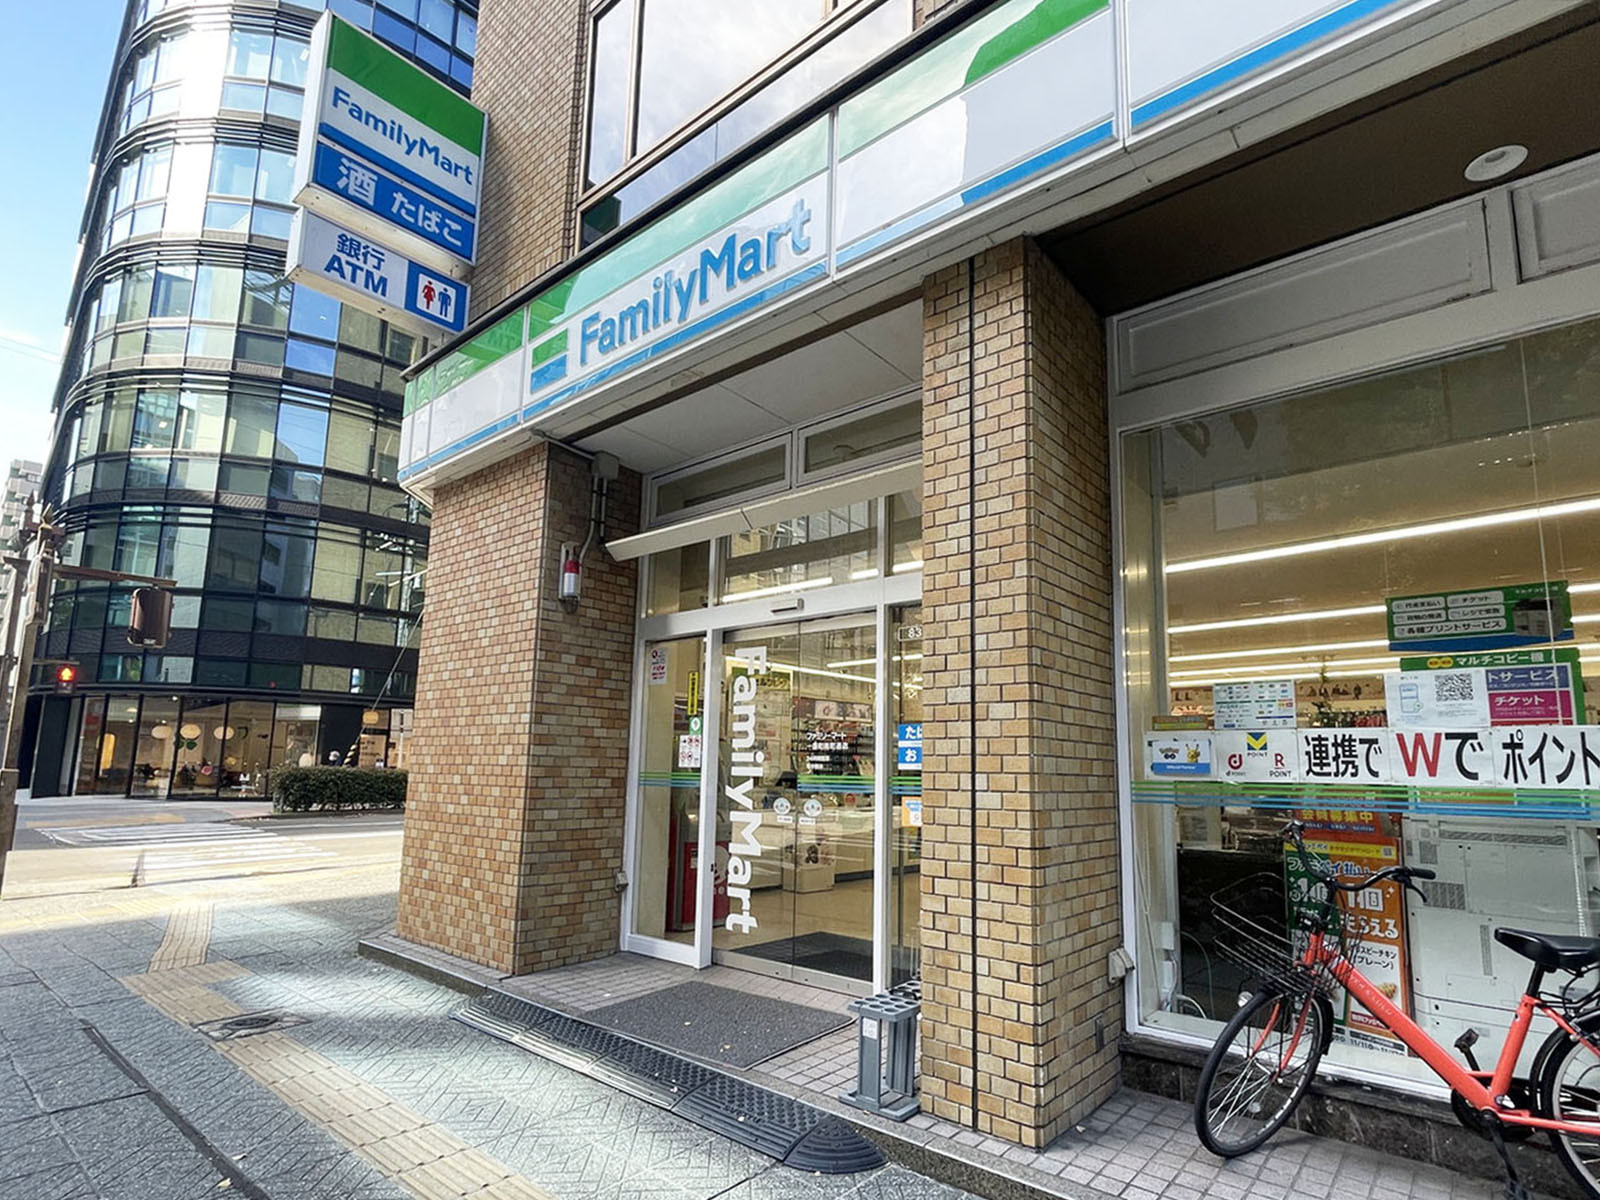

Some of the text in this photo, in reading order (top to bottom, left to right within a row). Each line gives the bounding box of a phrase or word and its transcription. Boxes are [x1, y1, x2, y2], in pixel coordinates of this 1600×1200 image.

[332, 86, 473, 186] FamilyMart
[336, 158, 463, 247] 酒 たばこ
[324, 254, 389, 298] ATM
[337, 232, 385, 271] 銀行
[580, 198, 811, 366] FamilyMart
[1456, 651, 1545, 666] マルチコピー機
[1494, 695, 1545, 706] チケット
[1304, 729, 1600, 786] 連携で Wで ポイント
[725, 645, 767, 934] FamilyMart
